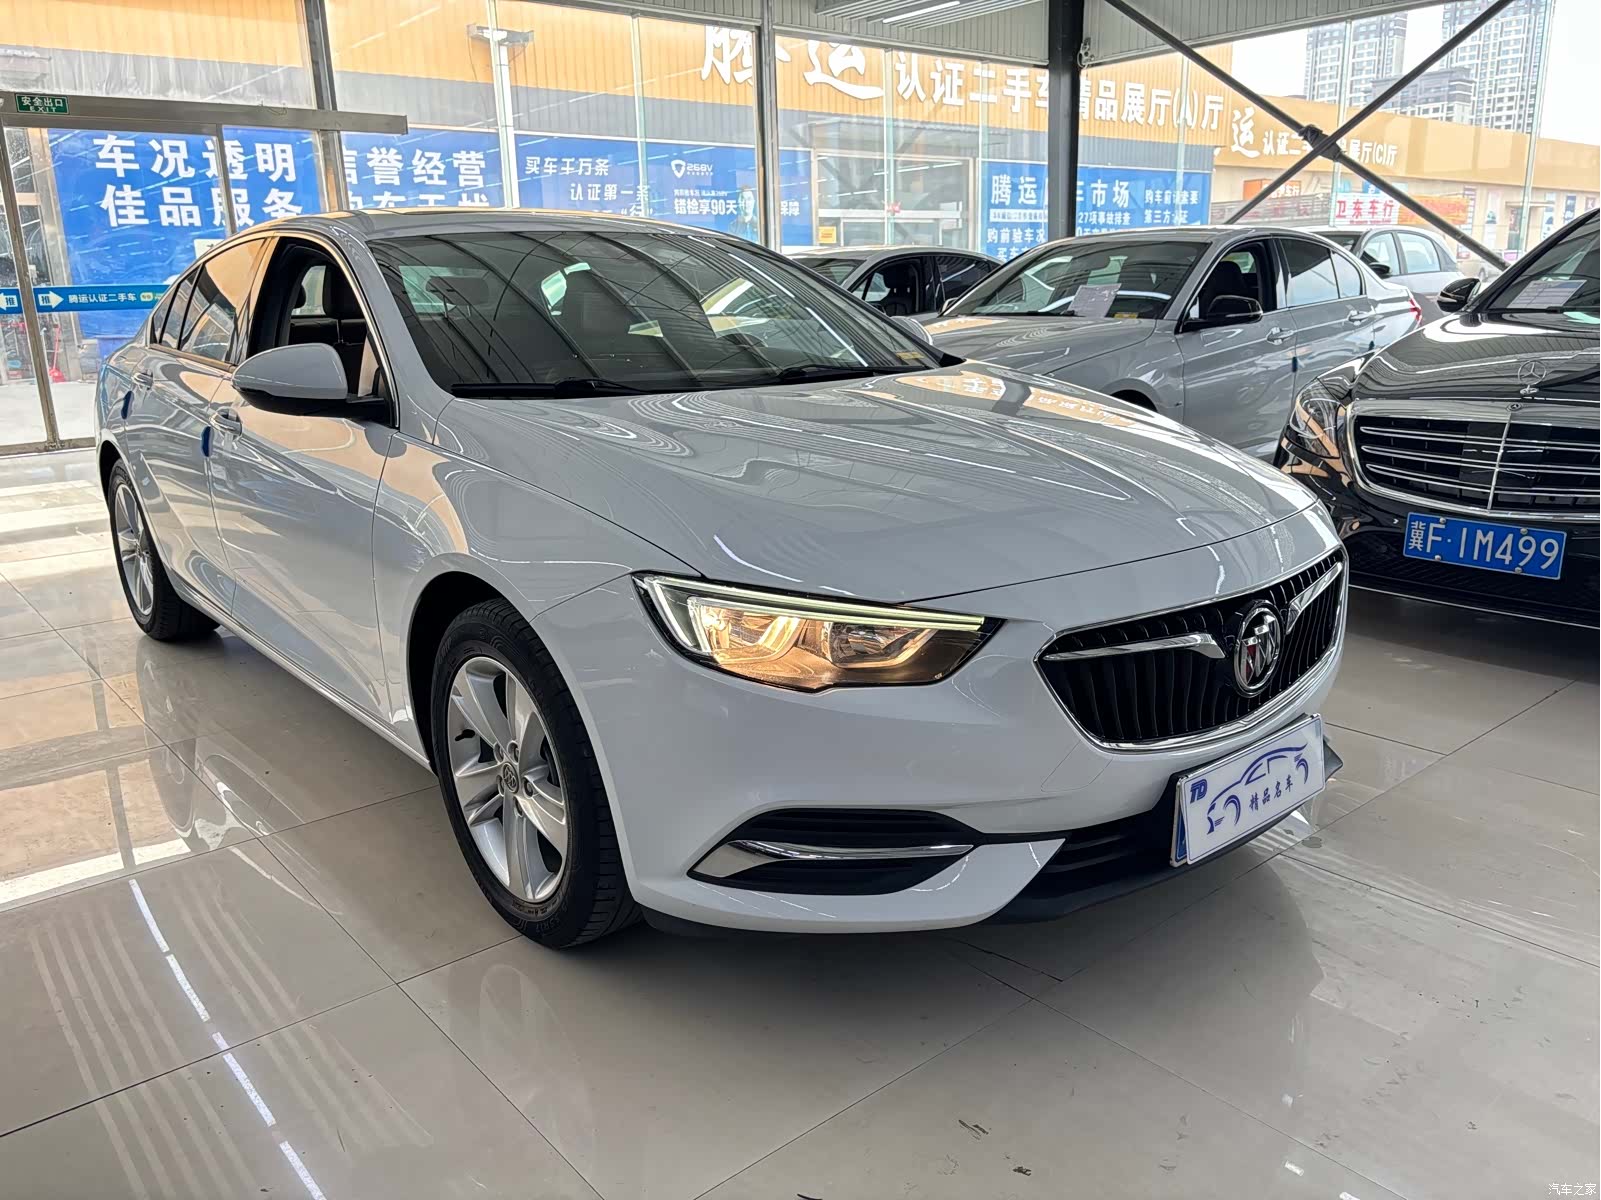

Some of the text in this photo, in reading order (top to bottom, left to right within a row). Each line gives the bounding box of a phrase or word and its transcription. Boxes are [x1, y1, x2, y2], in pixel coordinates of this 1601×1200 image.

[21, 96, 63, 107] 安全出口
[93, 134, 297, 182] 车况透明
[525, 156, 609, 176] 买车千万条
[570, 183, 649, 201] 认证第一条
[100, 184, 303, 228] 佳品服务
[1336, 199, 1395, 218] 卫东车行
[1249, 774, 1293, 812] 精品名车
